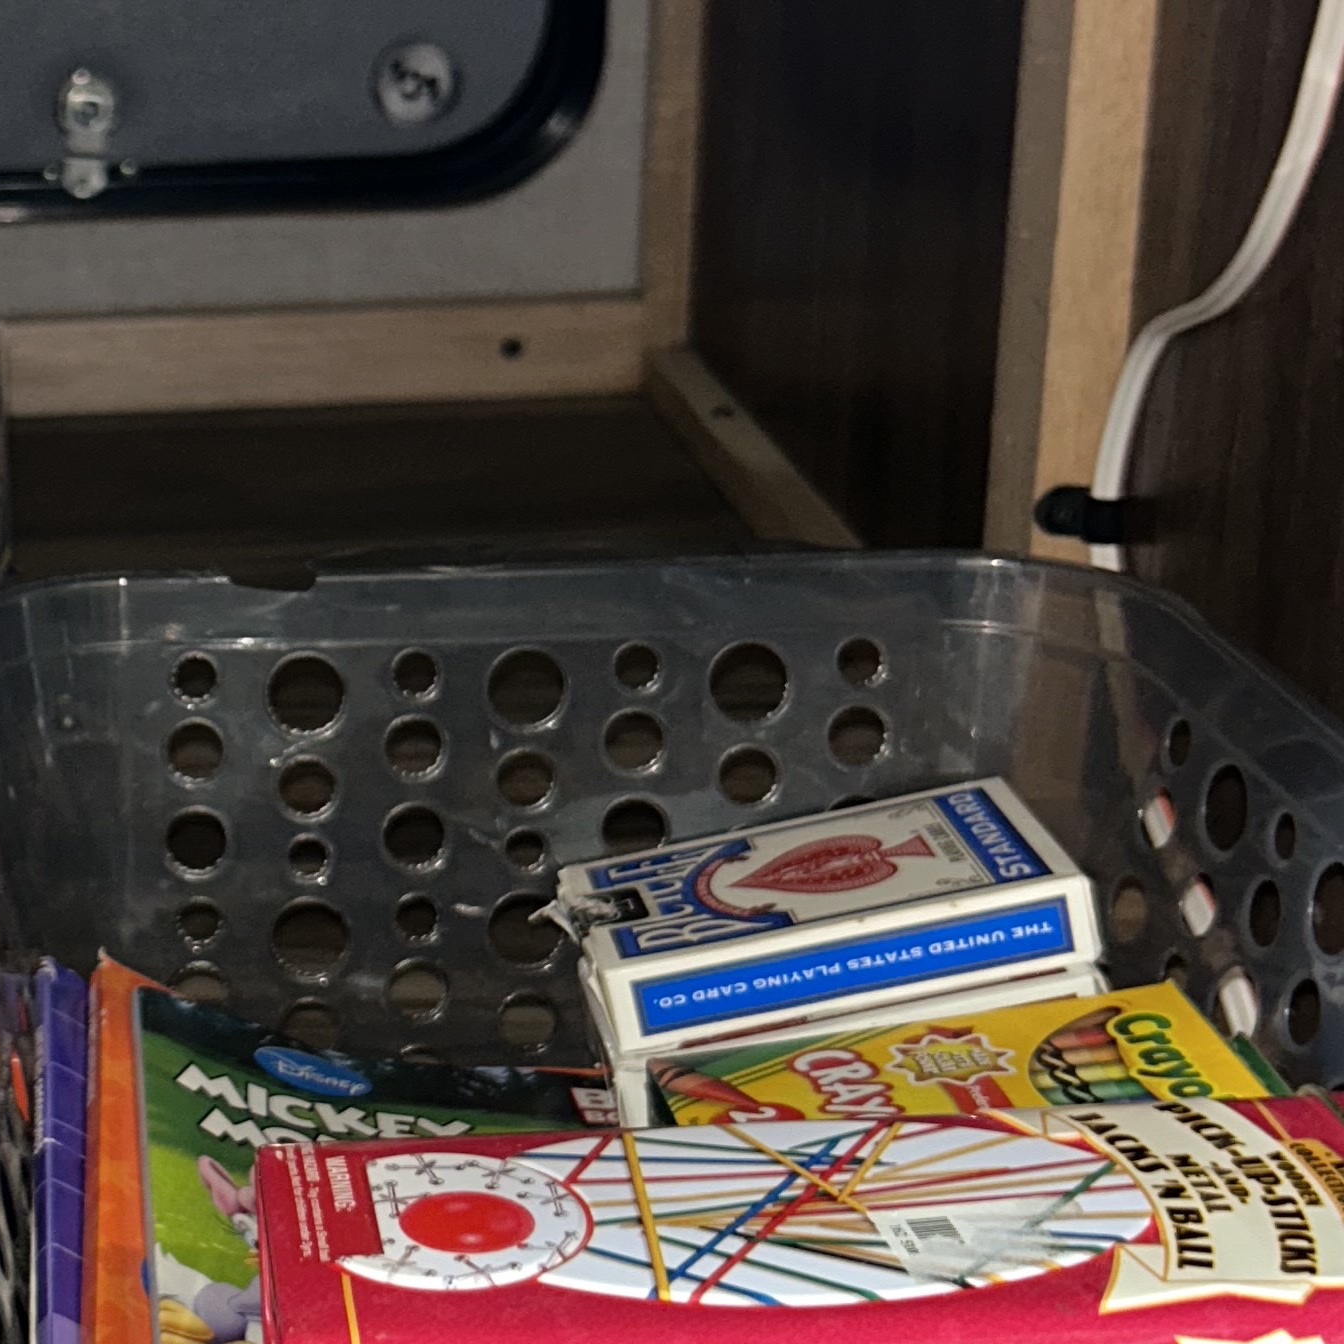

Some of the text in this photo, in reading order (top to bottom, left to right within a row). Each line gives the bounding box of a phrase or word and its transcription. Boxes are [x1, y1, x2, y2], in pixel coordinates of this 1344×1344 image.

[946, 792, 1033, 878] STANDARD
[654, 919, 1053, 1009] THE UNITED STATES PLAYING CARD CO.
[274, 1057, 367, 1094] Disney
[792, 1049, 901, 1116] CRAY
[1113, 1012, 1214, 1099] Crayo
[175, 1062, 476, 1138] MICKEY
[324, 1155, 357, 1213] WARNING:
[1070, 1113, 1172, 1174] JACKS
[1166, 1207, 1213, 1270] BALL
[1151, 1102, 1318, 1276] PICK-UP-STICKS
[1165, 1153, 1234, 1214] METAL
[1268, 1150, 1325, 1207] WOODEN
